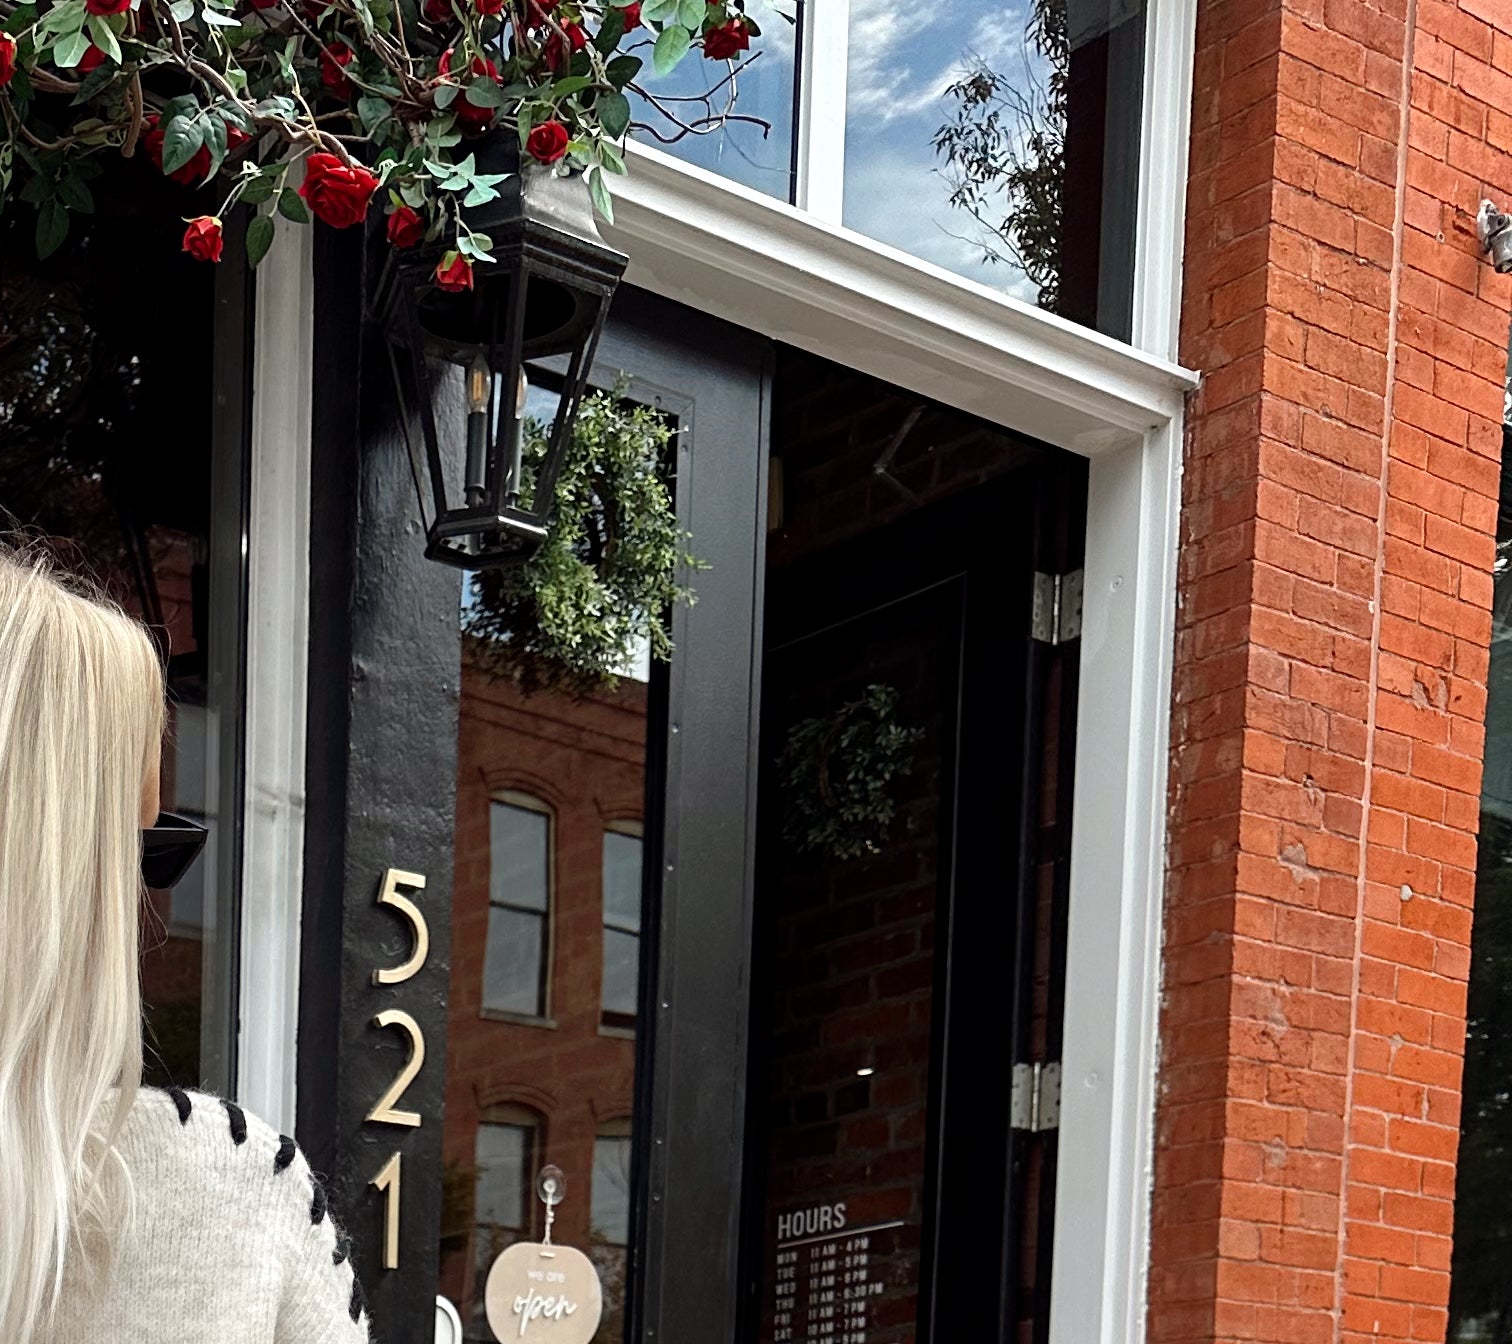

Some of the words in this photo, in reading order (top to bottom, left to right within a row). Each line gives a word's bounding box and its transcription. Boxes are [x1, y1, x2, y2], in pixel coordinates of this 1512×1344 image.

[364, 868, 429, 1270] 521
[777, 1203, 846, 1239] HOURS
[776, 1252, 798, 1265] MON
[822, 1244, 836, 1256] AM
[846, 1241, 852, 1251] 4
[854, 1237, 869, 1250] PM
[546, 1271, 565, 1283] are
[777, 1267, 796, 1280] TUE
[821, 1259, 835, 1272] AM
[853, 1254, 868, 1266] PM
[775, 1282, 796, 1295] WED
[821, 1275, 835, 1287] AM
[853, 1269, 867, 1281] PM
[820, 1291, 834, 1303] AM
[868, 1282, 883, 1295] PM
[513, 1287, 578, 1336] open
[819, 1306, 834, 1318] AM
[851, 1301, 865, 1313] PM
[774, 1328, 792, 1341] SAT
[819, 1321, 834, 1334] AM
[851, 1316, 866, 1329] PM
[850, 1332, 865, 1344] PM
